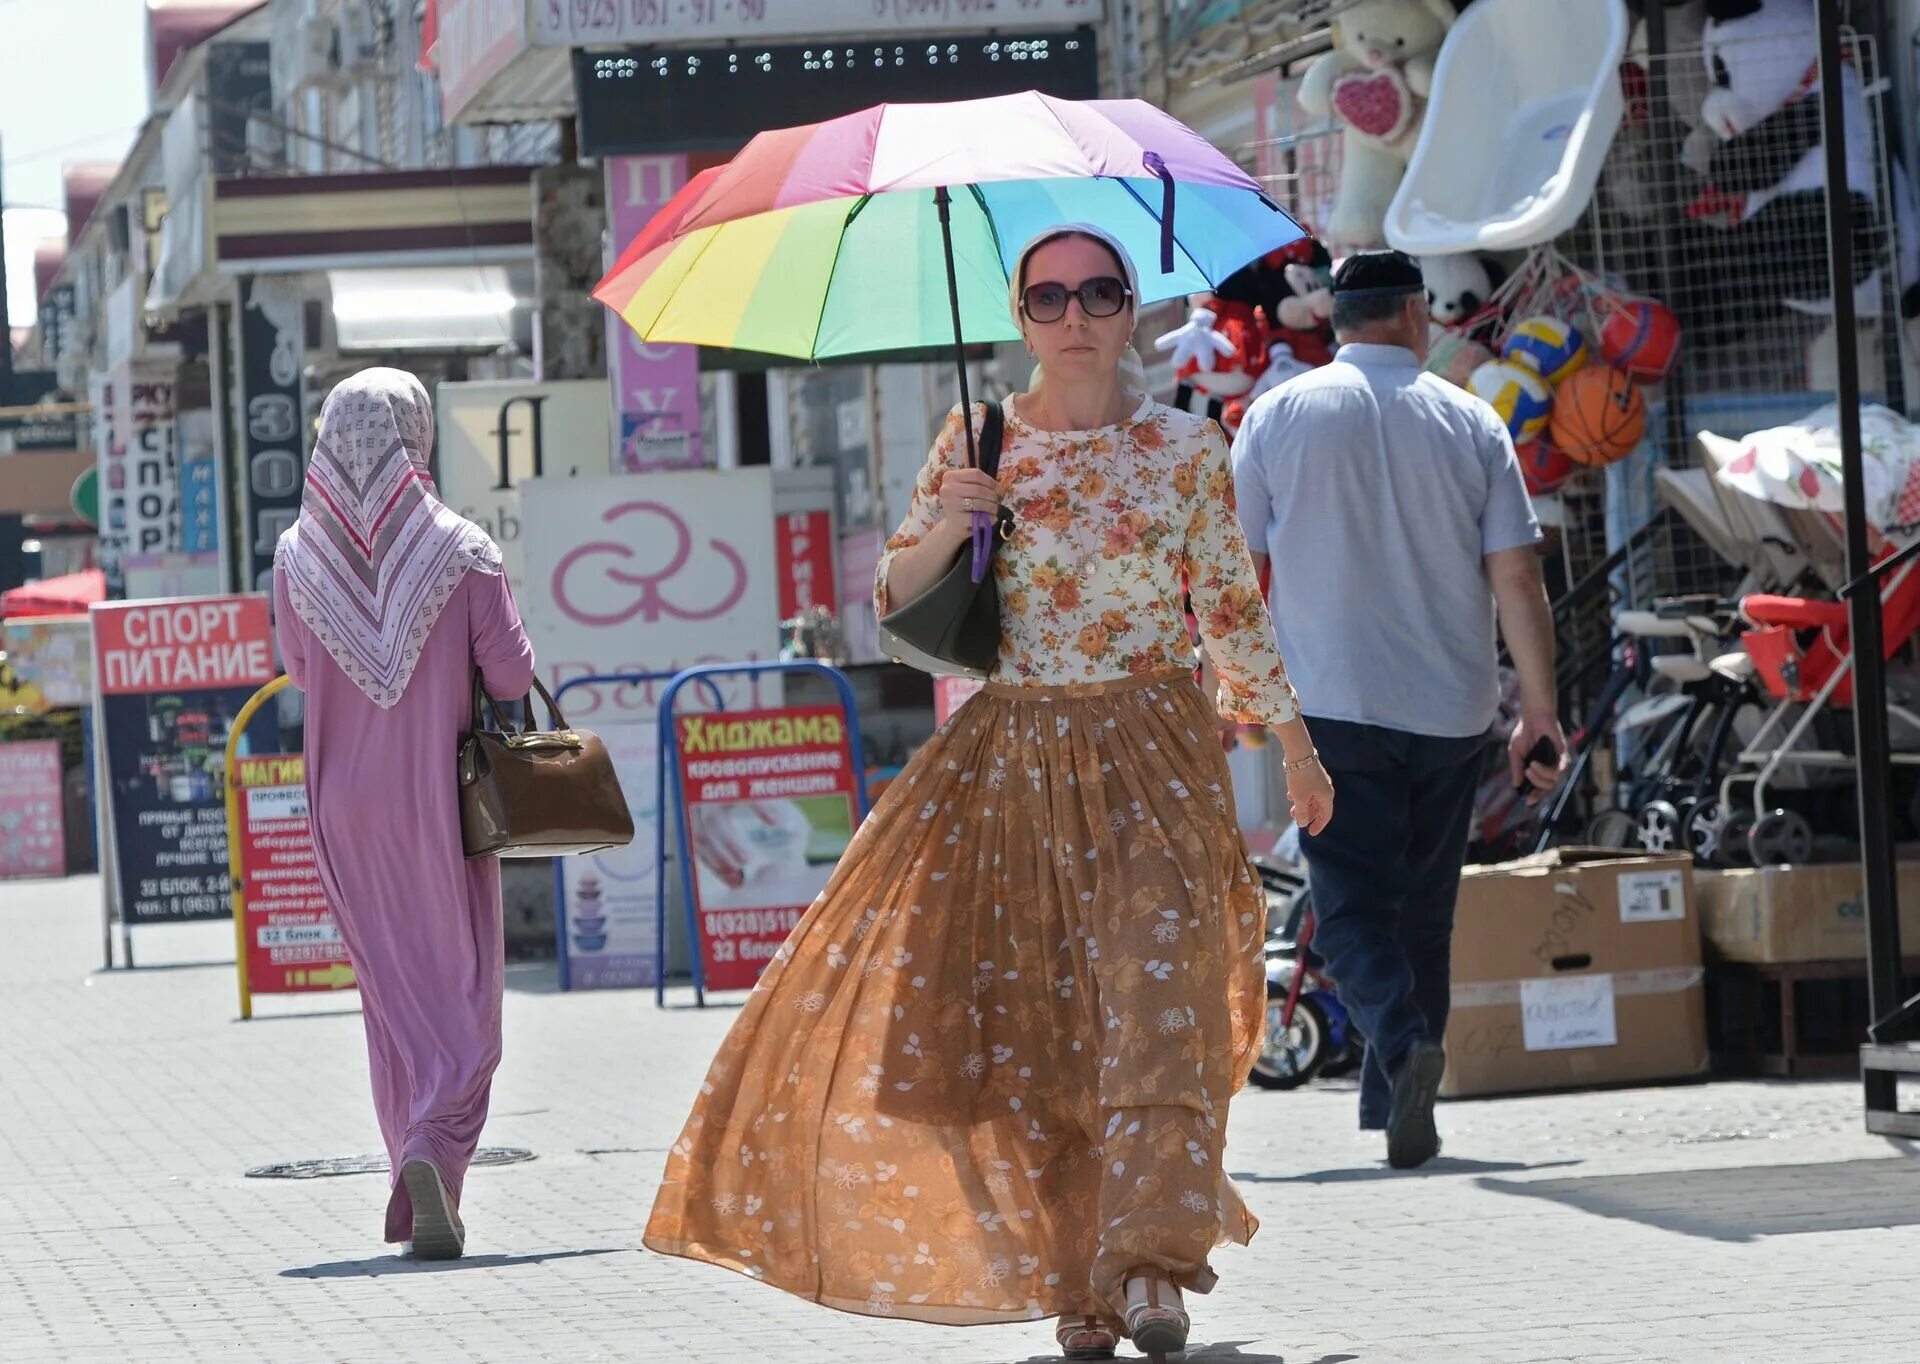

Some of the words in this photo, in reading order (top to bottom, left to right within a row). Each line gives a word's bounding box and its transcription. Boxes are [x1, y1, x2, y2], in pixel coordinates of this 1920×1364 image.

[123, 602, 243, 647] СПОРТ
[104, 640, 270, 688] ПИТАНИЕ
[682, 714, 842, 755] Хиджама
[701, 781, 740, 800] для
[749, 775, 837, 798] женщин
[140, 878, 160, 897] 32
[713, 942, 737, 962] 32
